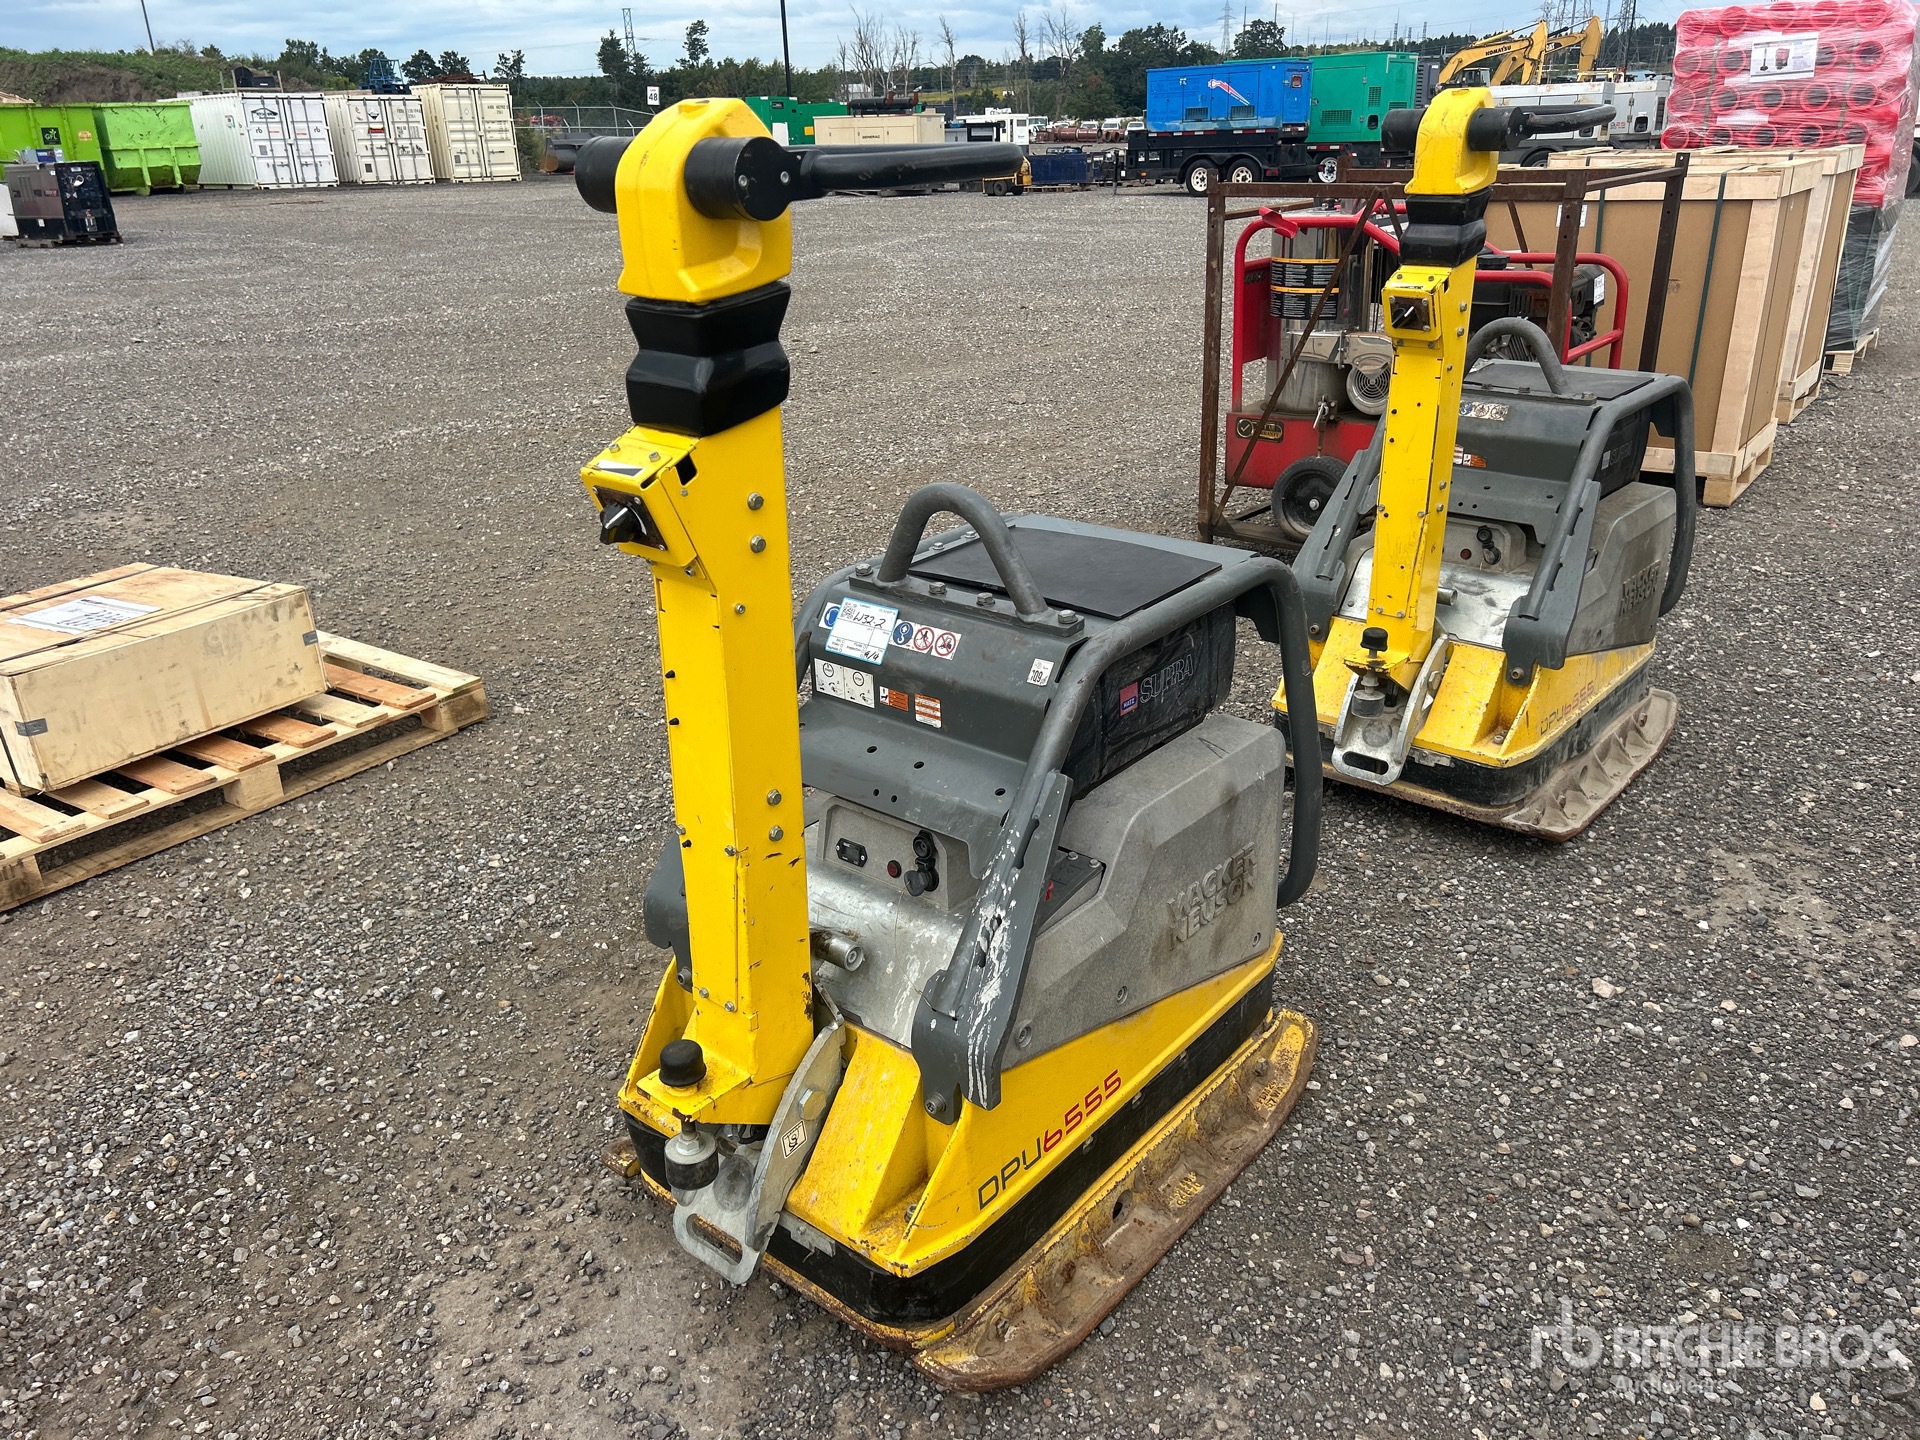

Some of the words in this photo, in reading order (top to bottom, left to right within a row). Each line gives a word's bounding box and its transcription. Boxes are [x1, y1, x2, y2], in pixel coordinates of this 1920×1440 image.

[1485, 45, 1512, 56] KOMATSU
[649, 93, 658, 101] 48
[44, 132, 58, 140] GFL
[853, 611, 886, 628] W32-2
[1030, 670, 1044, 683] 109
[1139, 654, 1194, 704] SUPRA
[1123, 698, 1136, 709] HATZ
[1540, 680, 1595, 736] DPU6555
[1167, 842, 1257, 921] WACKER
[1171, 872, 1256, 950] NEUSON
[977, 1069, 1123, 1211] DPU6555
